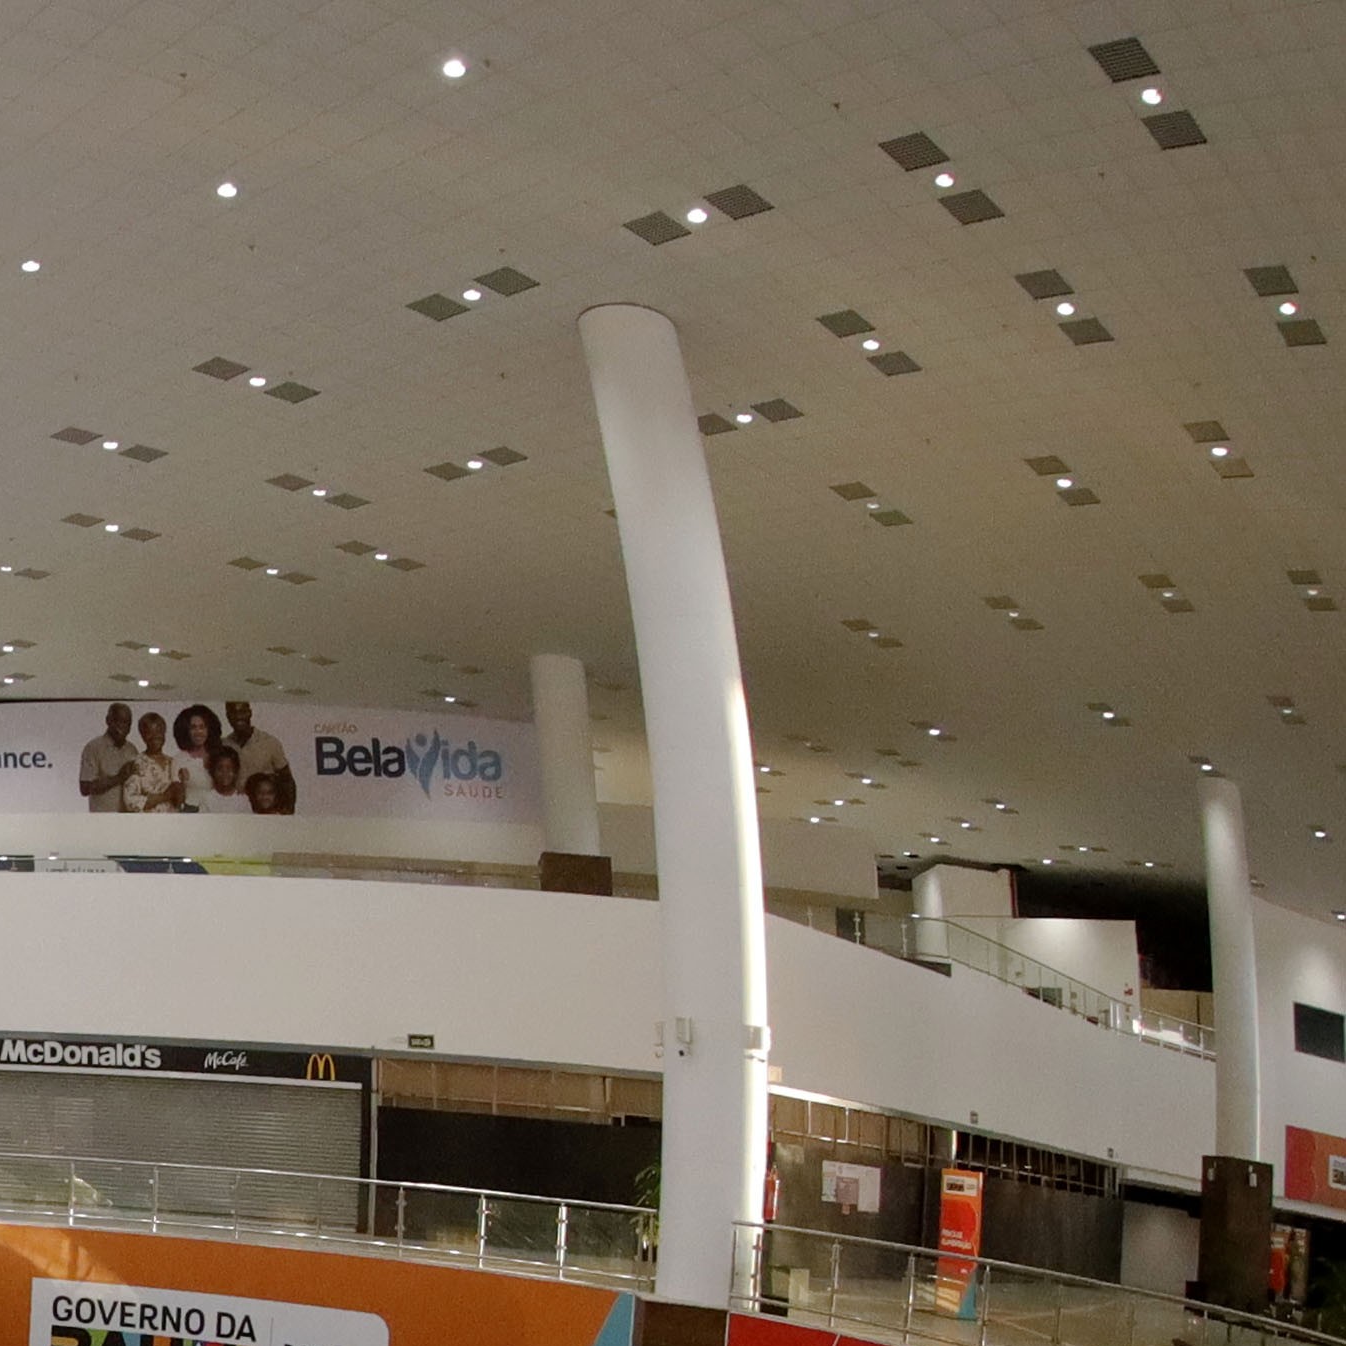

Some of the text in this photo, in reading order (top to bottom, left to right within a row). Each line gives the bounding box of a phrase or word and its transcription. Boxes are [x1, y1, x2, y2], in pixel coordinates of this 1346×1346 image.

[0, 1039, 161, 1068] McDonald's
[52, 1295, 257, 1342] GOVERNO DA
